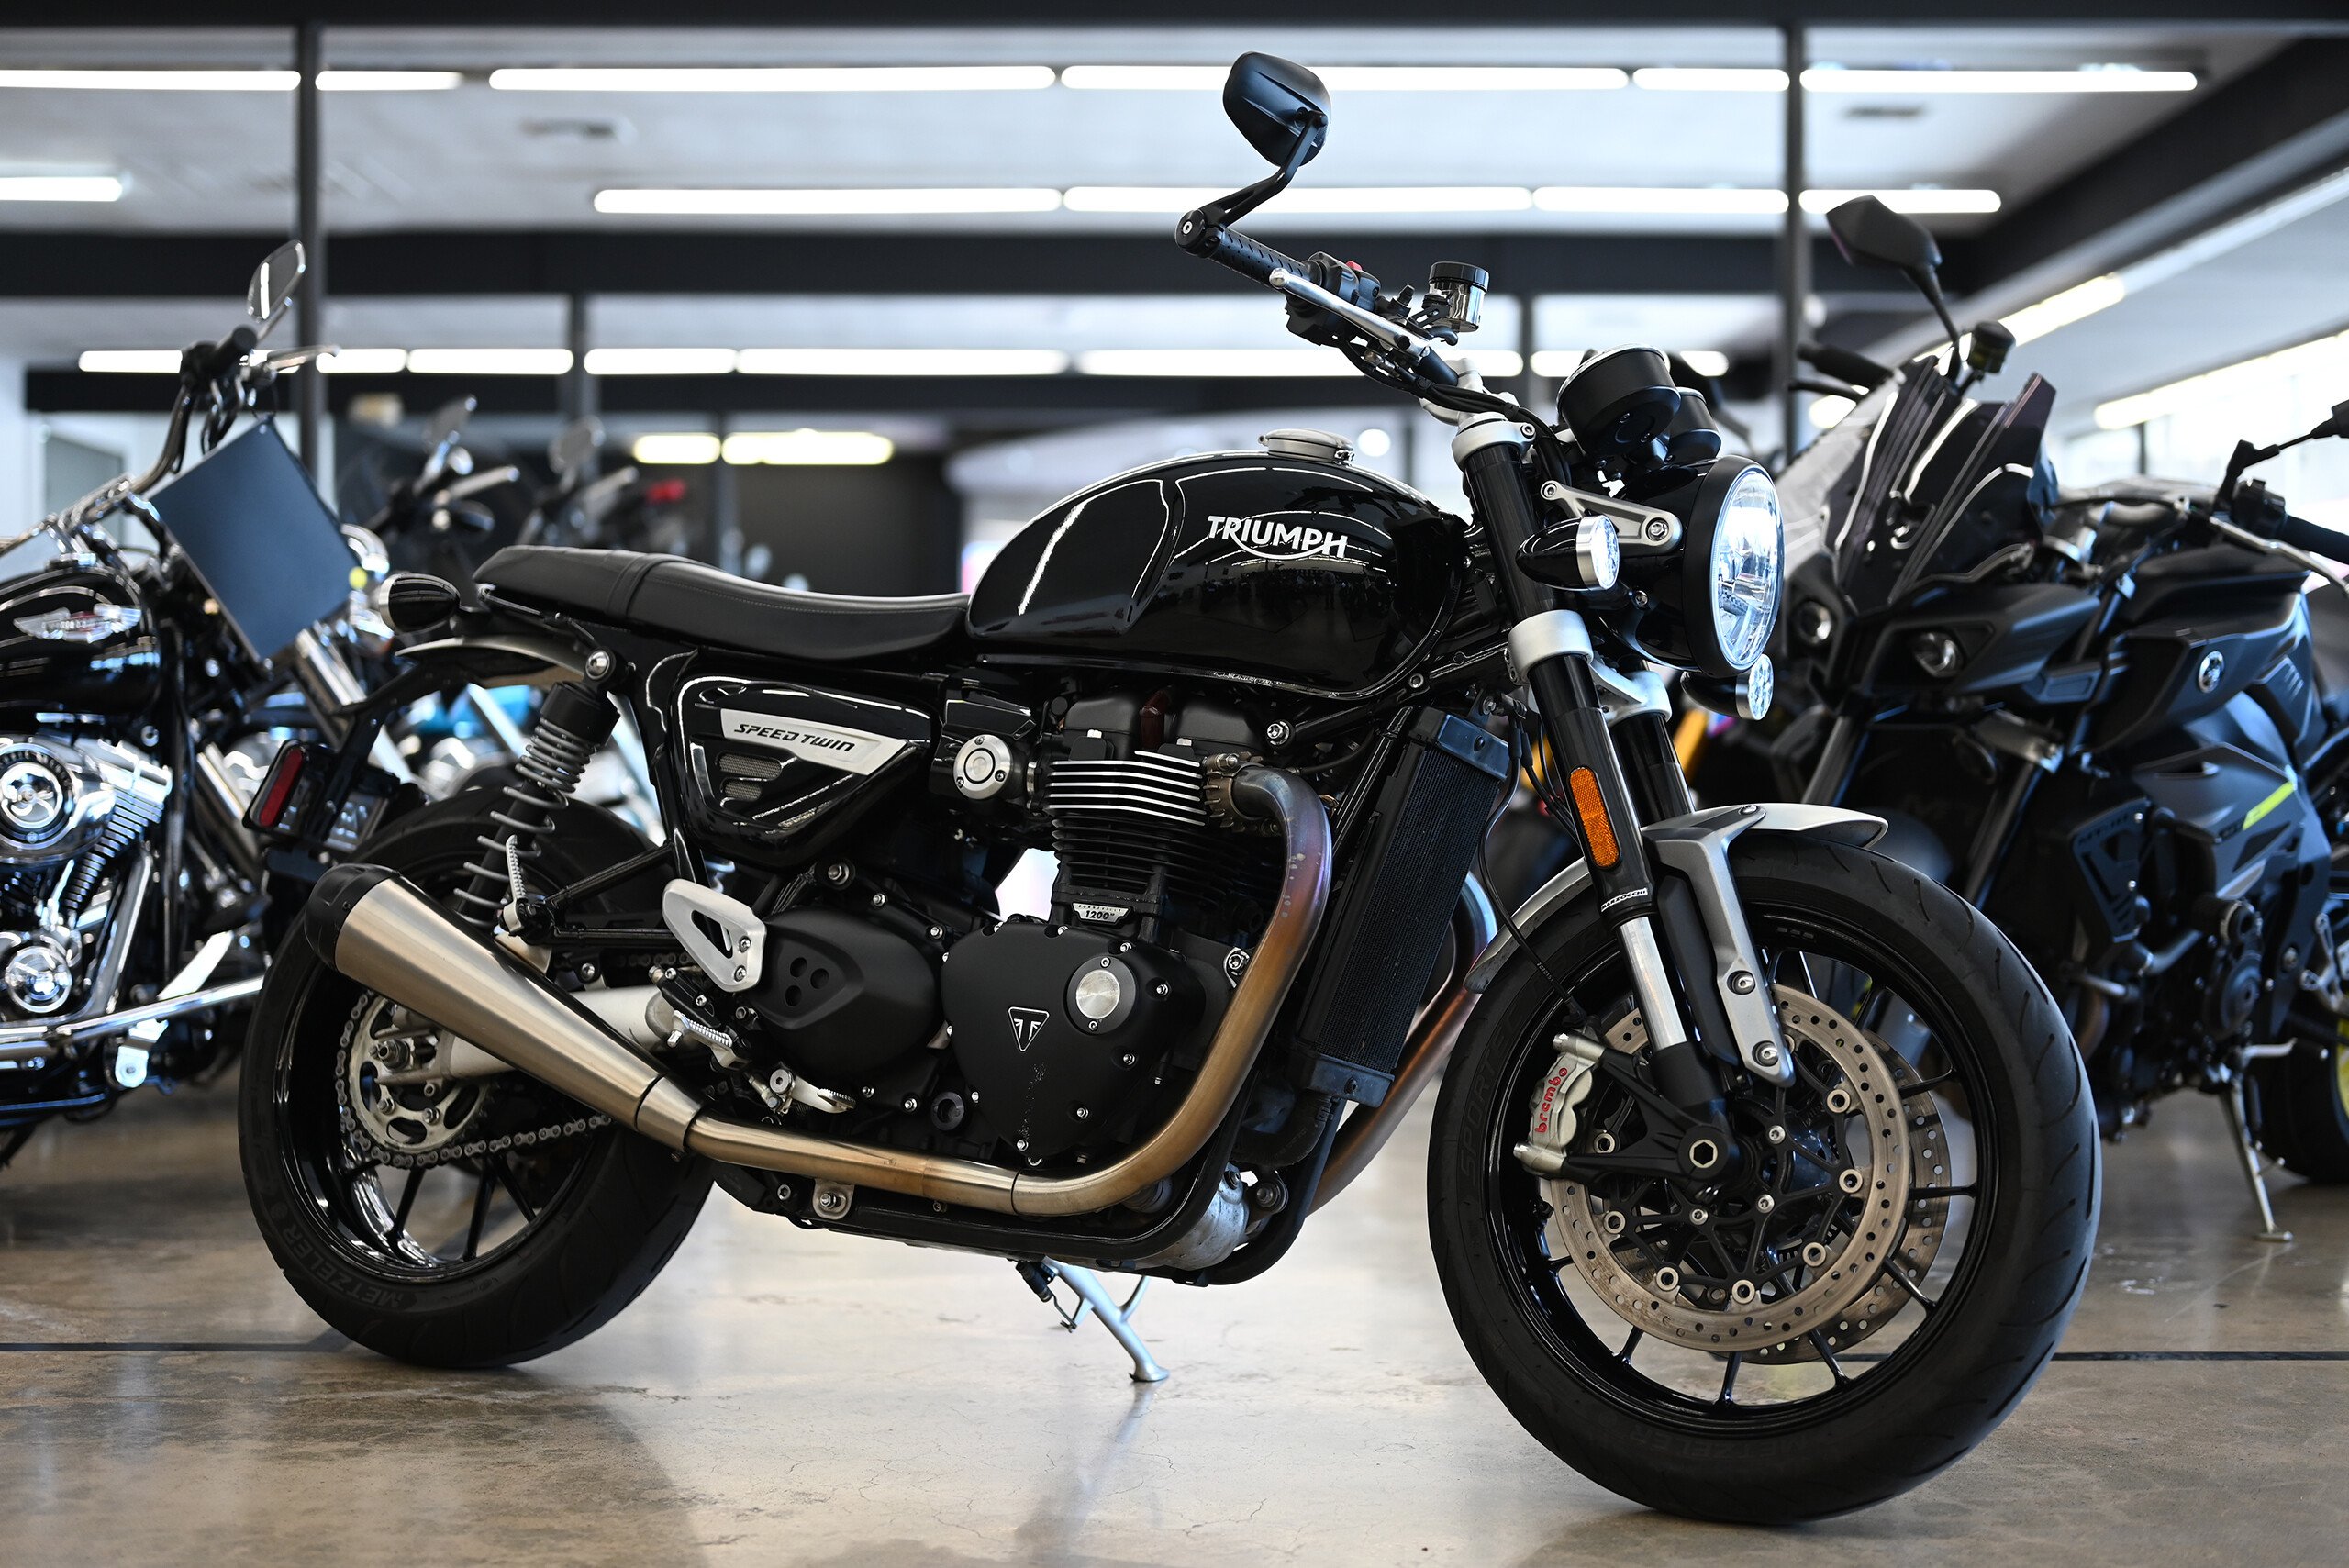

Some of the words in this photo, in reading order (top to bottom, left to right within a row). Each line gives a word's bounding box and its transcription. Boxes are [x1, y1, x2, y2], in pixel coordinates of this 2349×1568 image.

[1207, 516, 1349, 560] TRIUMPH
[734, 723, 798, 741] SPEED
[802, 734, 855, 751] TWIN
[1085, 911, 1110, 919] 1200
[1600, 888, 1648, 911] MARZOCCHI
[1460, 1004, 1523, 1180] SPORTEC
[1534, 1067, 1568, 1134] brembo
[282, 1223, 404, 1308] METZELER
